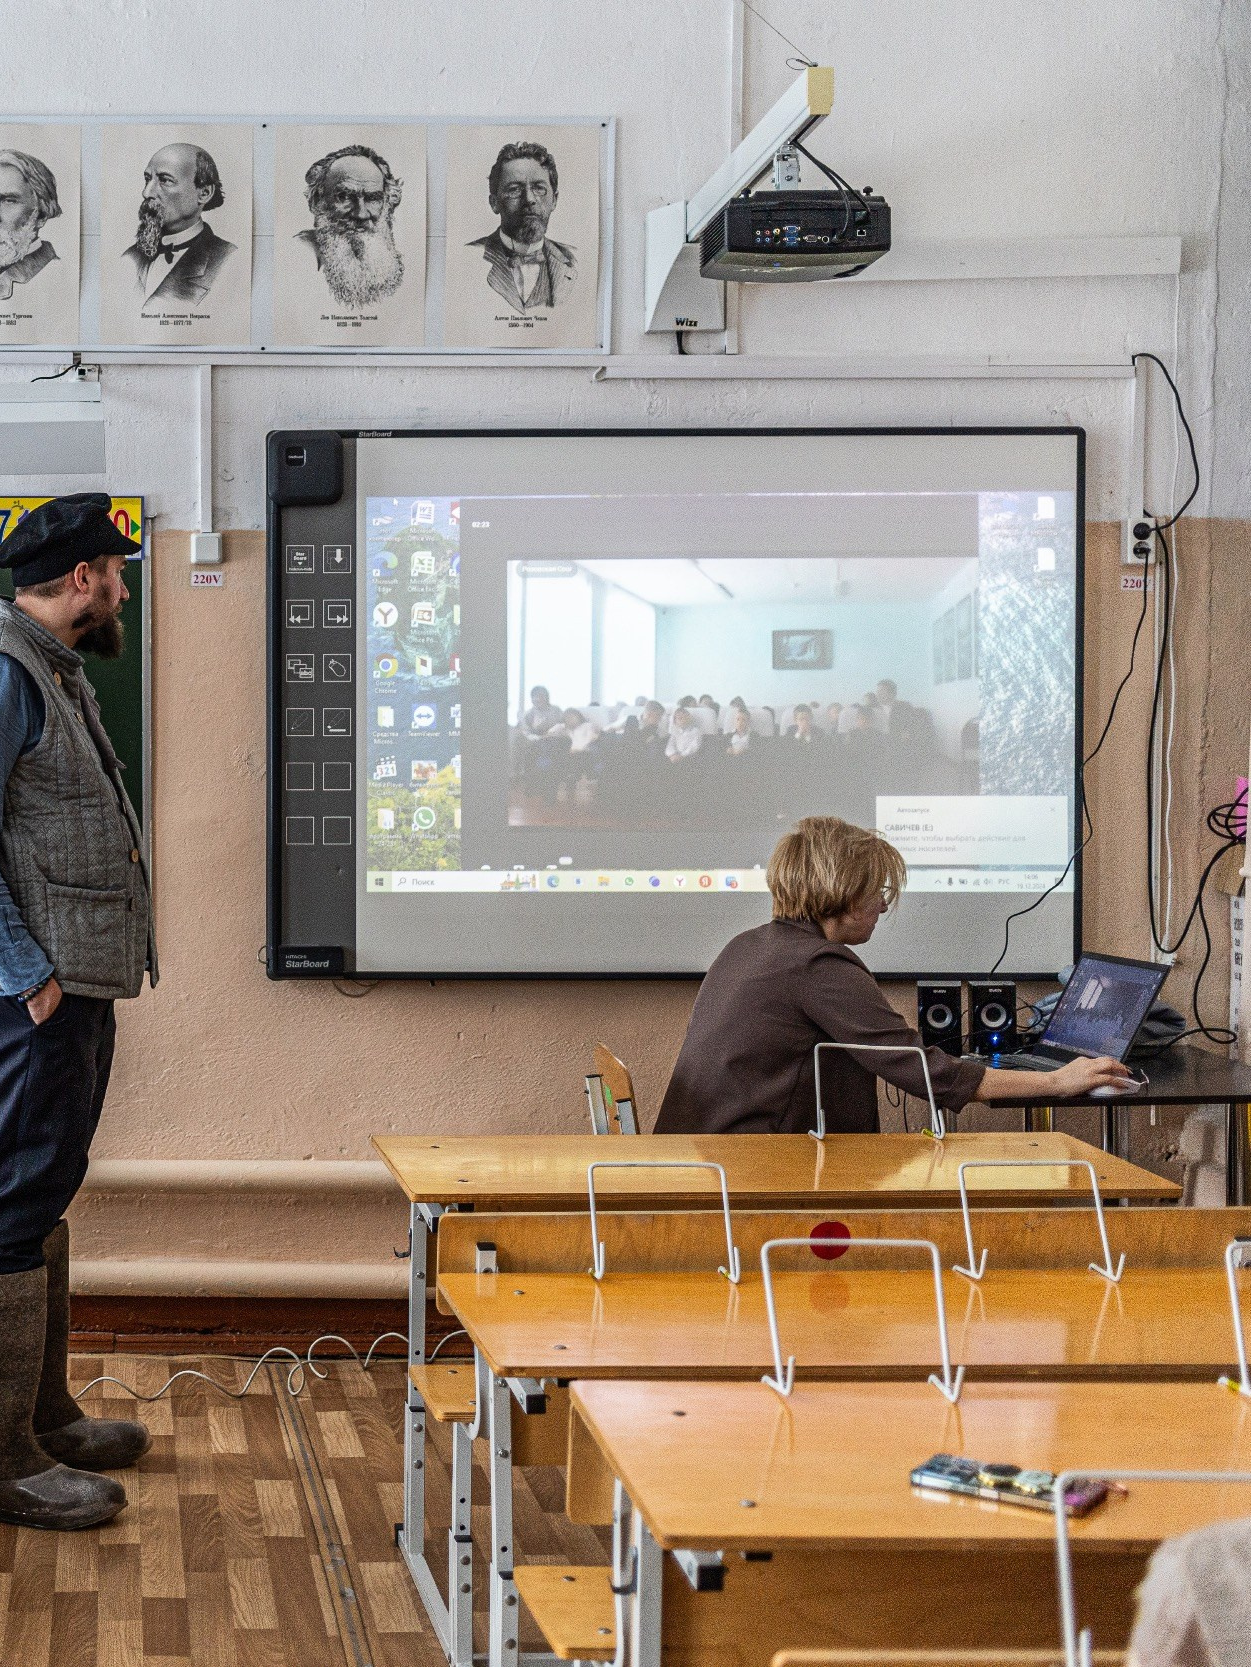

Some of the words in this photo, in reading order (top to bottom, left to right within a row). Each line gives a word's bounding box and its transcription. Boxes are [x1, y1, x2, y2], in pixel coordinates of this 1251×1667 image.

[107, 509, 130, 538] 0
[193, 574, 221, 584] 220V
[1123, 579, 1151, 589] 220
[411, 878, 435, 886] Поиск
[285, 960, 330, 968] StarBoard
